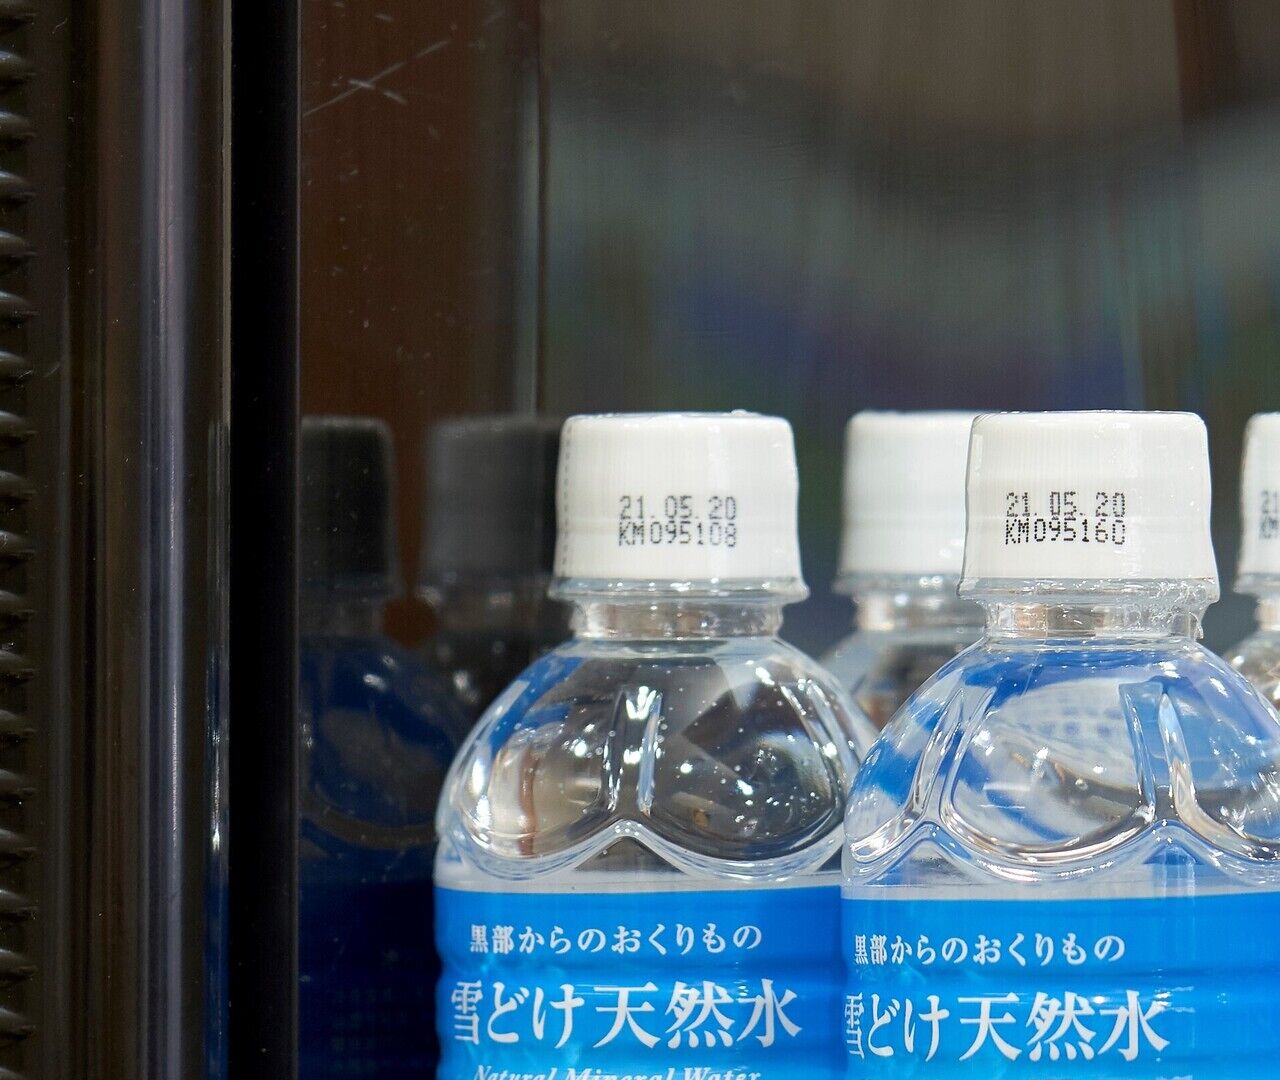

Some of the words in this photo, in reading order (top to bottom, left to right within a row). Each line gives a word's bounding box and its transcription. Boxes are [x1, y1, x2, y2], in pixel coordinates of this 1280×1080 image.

[1006, 492, 1126, 518] 21.05.20
[469, 922, 763, 956] 黒部からのおくりもの
[854, 932, 1126, 967] 黒部からのおくりもの
[450, 977, 803, 1050] 雪どけ天然水
[843, 989, 1171, 1062] 雪どけ天然水
